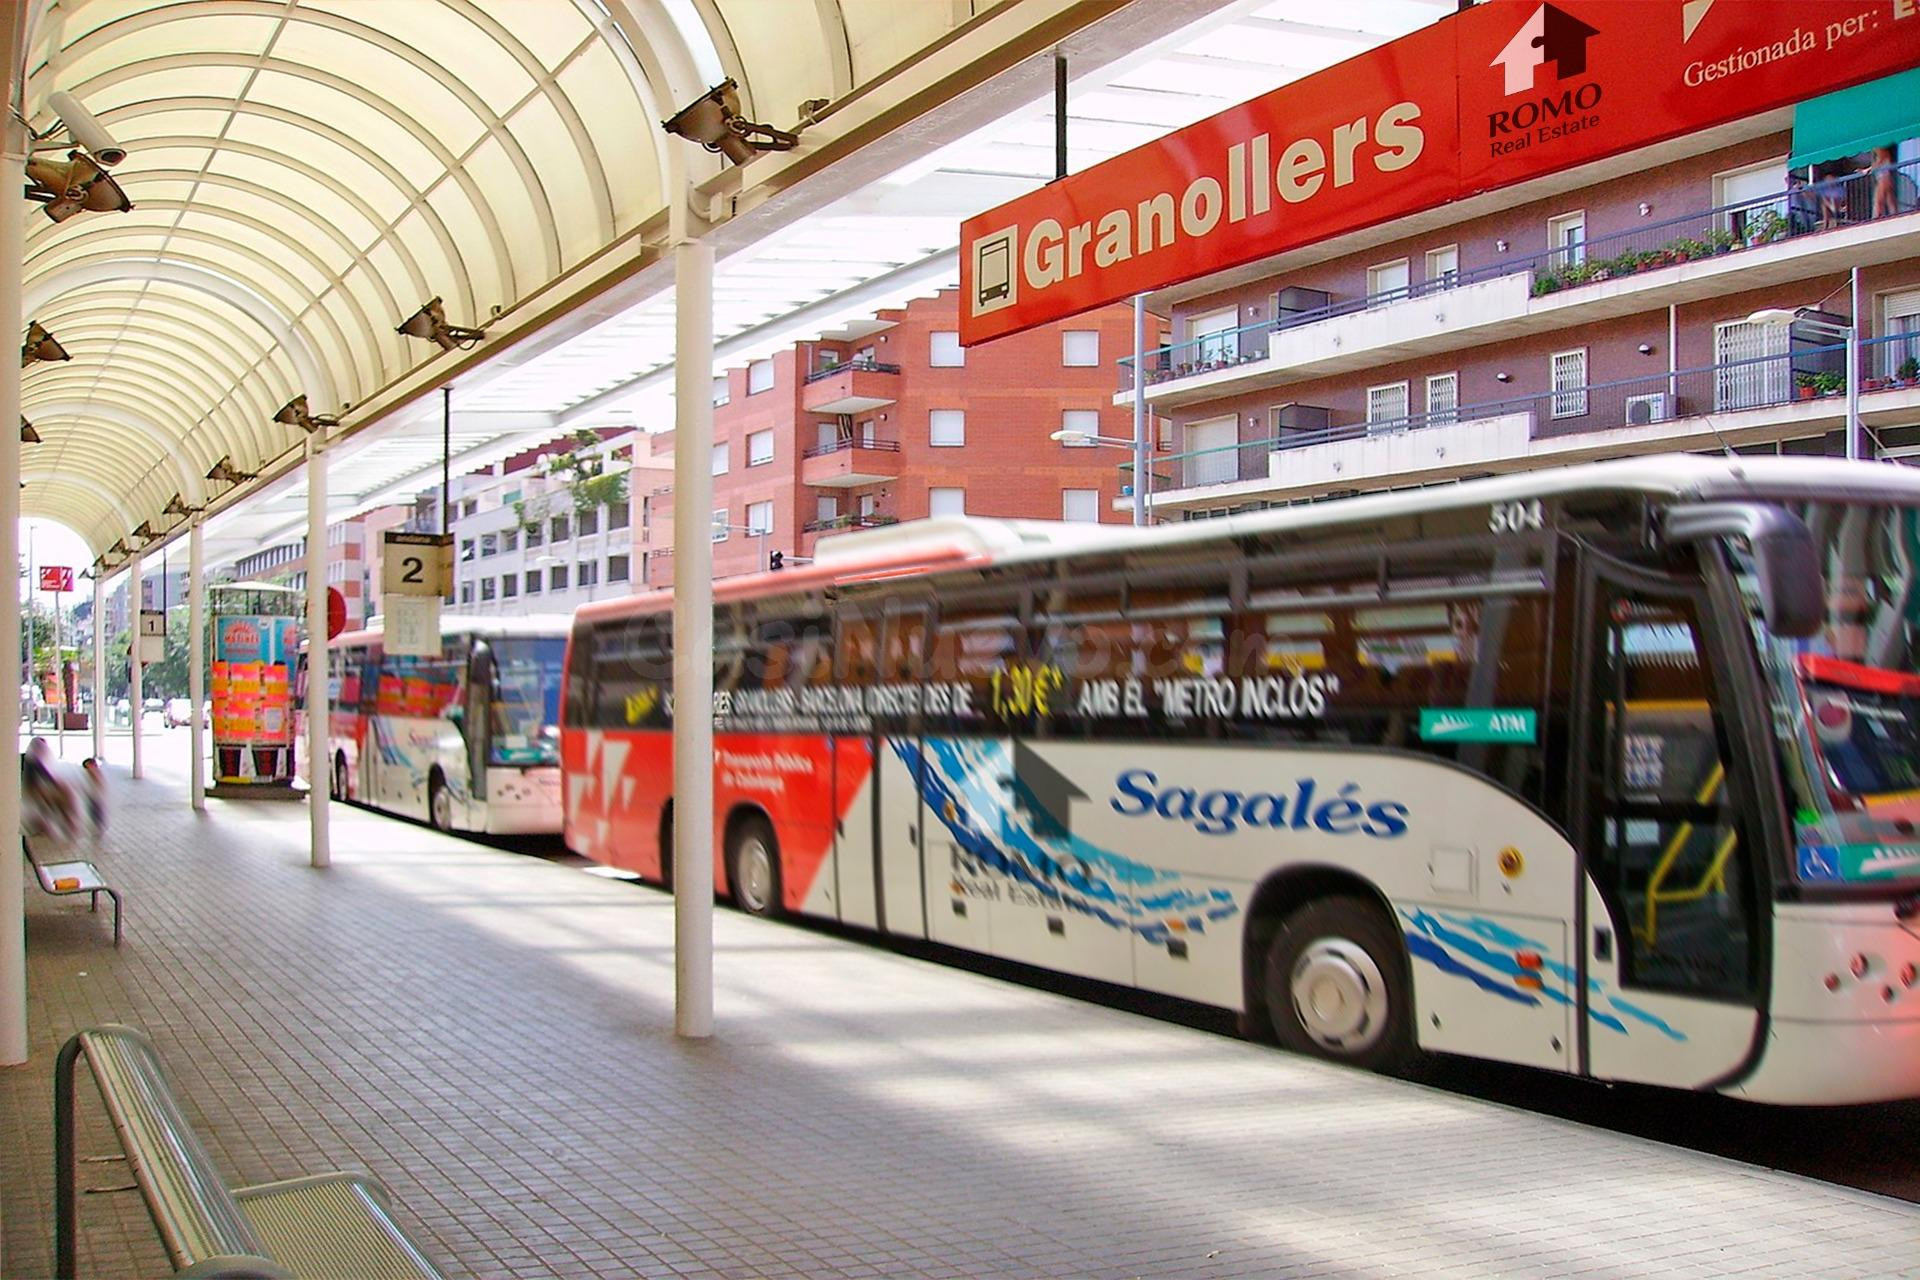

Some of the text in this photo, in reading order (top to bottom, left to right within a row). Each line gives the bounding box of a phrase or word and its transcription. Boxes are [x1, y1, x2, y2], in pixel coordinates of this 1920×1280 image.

[1683, 27, 1816, 87] Gestionada
[1825, 9, 1878, 50] per:
[1023, 101, 1425, 290] Granollers
[1489, 498, 1544, 533] 504
[401, 556, 424, 583] 2
[1109, 768, 1410, 839] Sagalés
